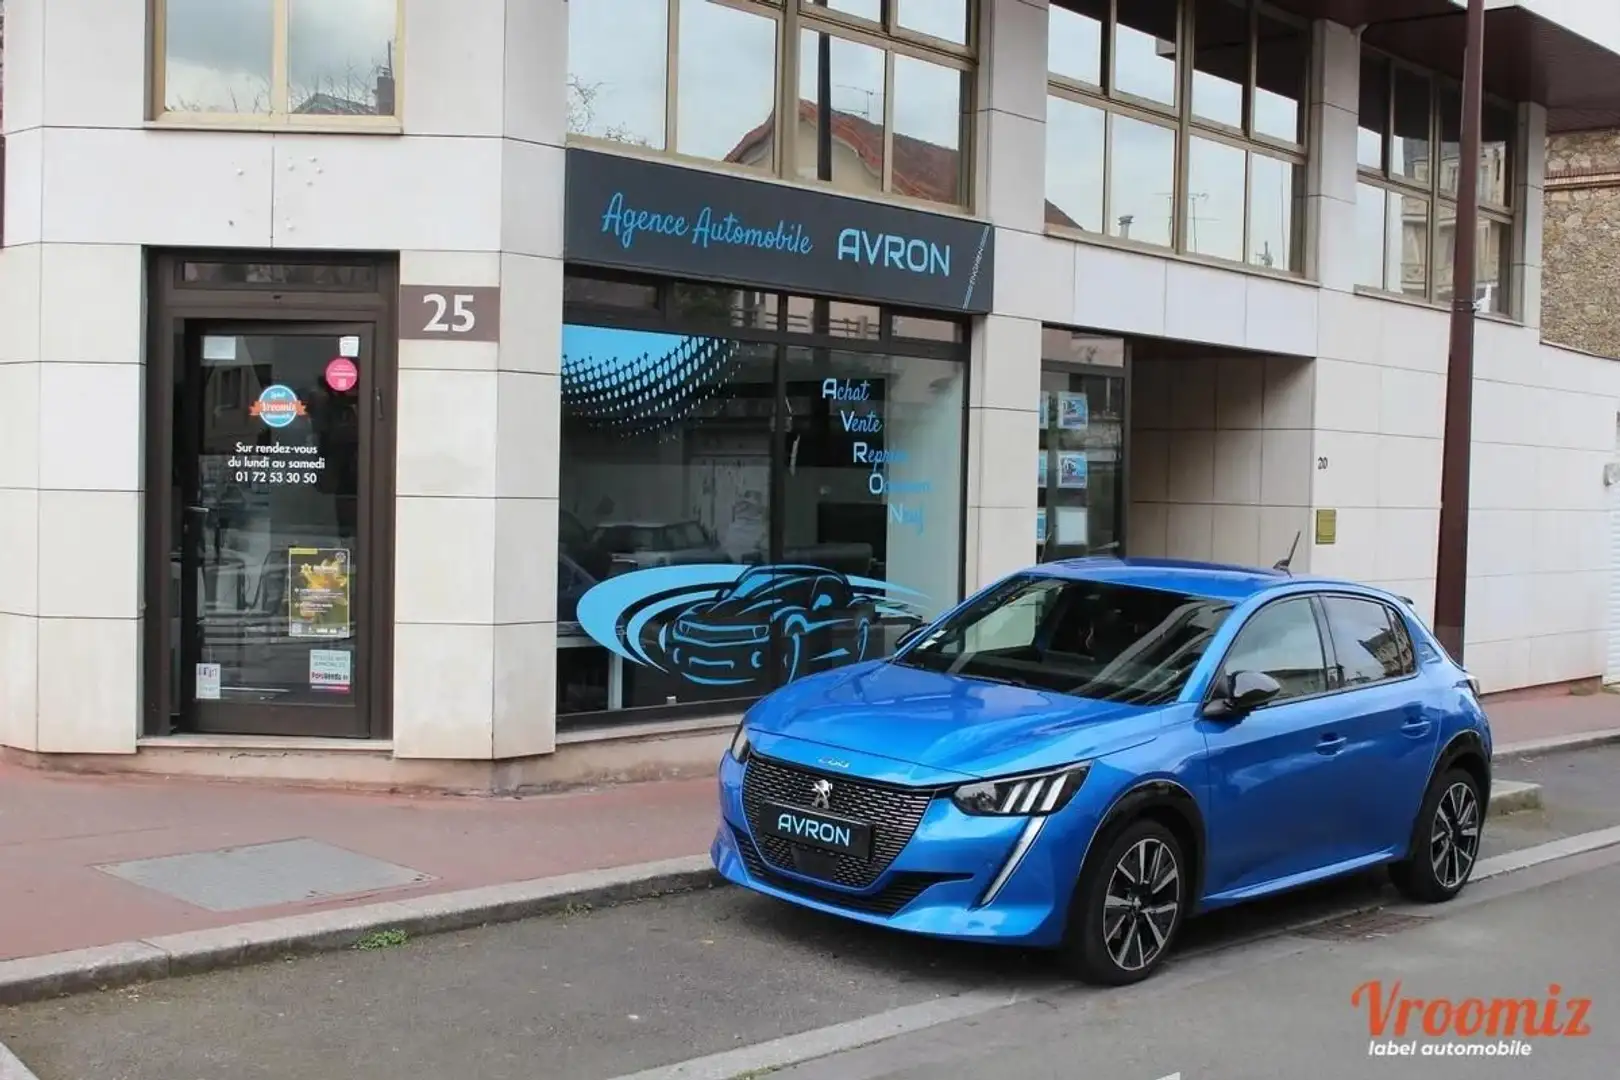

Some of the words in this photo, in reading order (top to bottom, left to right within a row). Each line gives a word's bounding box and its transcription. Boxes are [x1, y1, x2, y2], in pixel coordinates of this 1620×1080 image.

[602, 192, 688, 249] Agence
[692, 206, 813, 255] Automobile
[837, 228, 951, 277] AVRON
[422, 293, 475, 332] 25
[822, 378, 870, 400] Achat
[840, 410, 882, 433] Vente
[236, 442, 254, 453] Sur
[255, 442, 318, 454] rendez-vous
[853, 442, 908, 472] Repr
[228, 456, 242, 467] du
[244, 456, 270, 468] lundi
[271, 460, 286, 468] au
[288, 457, 325, 469] samedi
[235, 471, 249, 482] 01
[252, 471, 267, 482] 72
[269, 471, 284, 483] 53
[286, 472, 301, 483] 30
[303, 472, 317, 484] 50
[778, 813, 851, 847] AVRON
